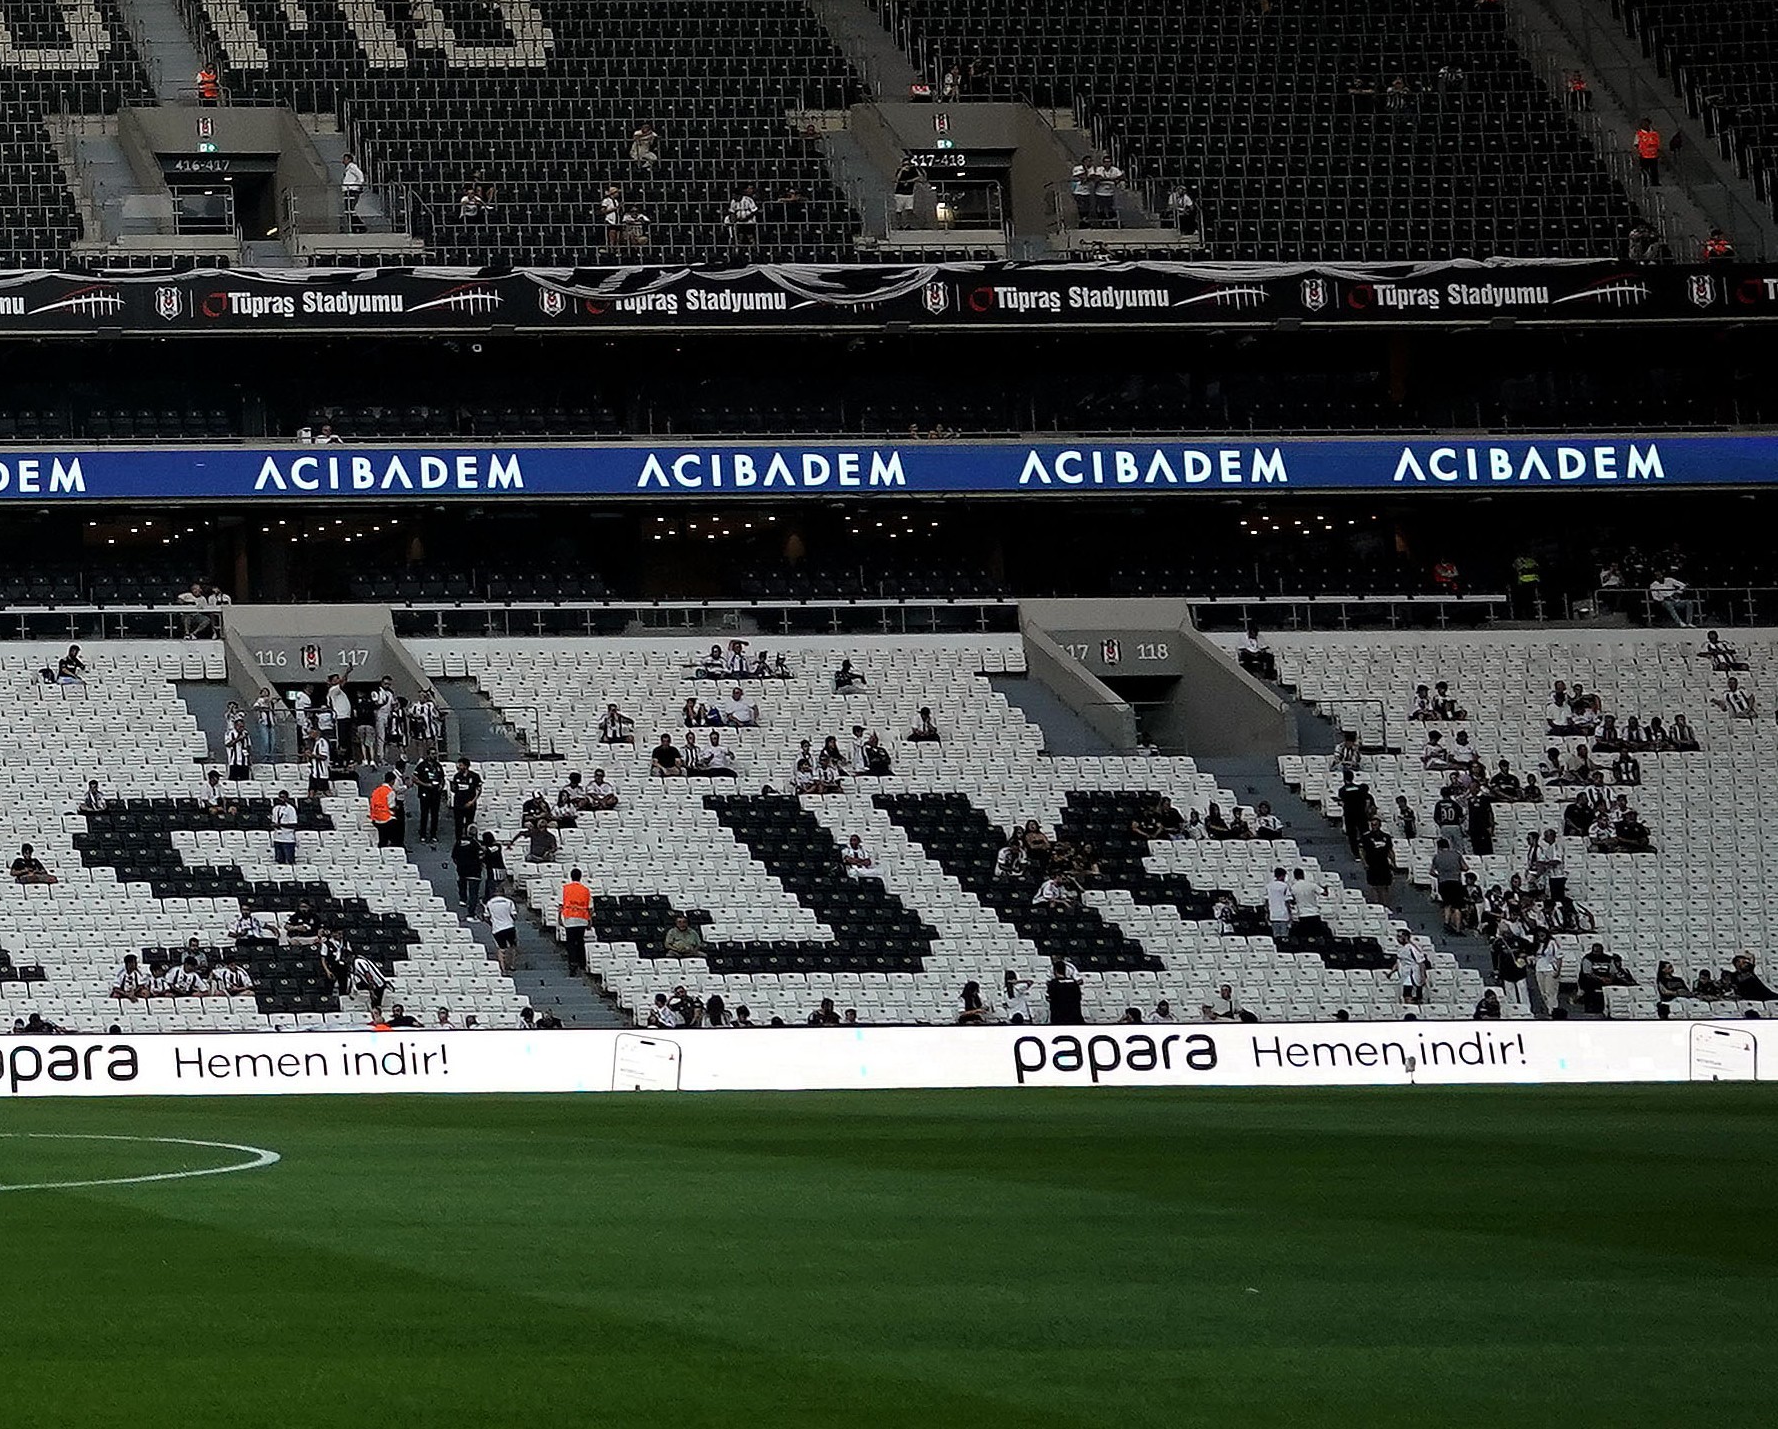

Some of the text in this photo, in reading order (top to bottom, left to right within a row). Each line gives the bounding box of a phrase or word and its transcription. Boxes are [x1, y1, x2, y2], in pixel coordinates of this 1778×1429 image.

[227, 291, 403, 318] Tüpraş Stadyumu
[685, 288, 787, 313] Stadyumu
[993, 286, 1170, 312] Tüpraş Stadyumu
[1372, 282, 1549, 309] Tüpraş Stadyumu
[255, 454, 523, 489] ACIBADEM
[638, 451, 905, 487] ACIBADEM
[1020, 448, 1287, 483] ACIBADEM
[1394, 444, 1664, 480] ACIBADEM
[255, 649, 369, 666] 116 117
[1059, 643, 1169, 660] 17 118
[589, 791, 1395, 974] JK
[174, 1046, 328, 1079] Hemen
[342, 1043, 449, 1076] indir!
[1013, 1032, 1527, 1083] papara Hemen indir!
